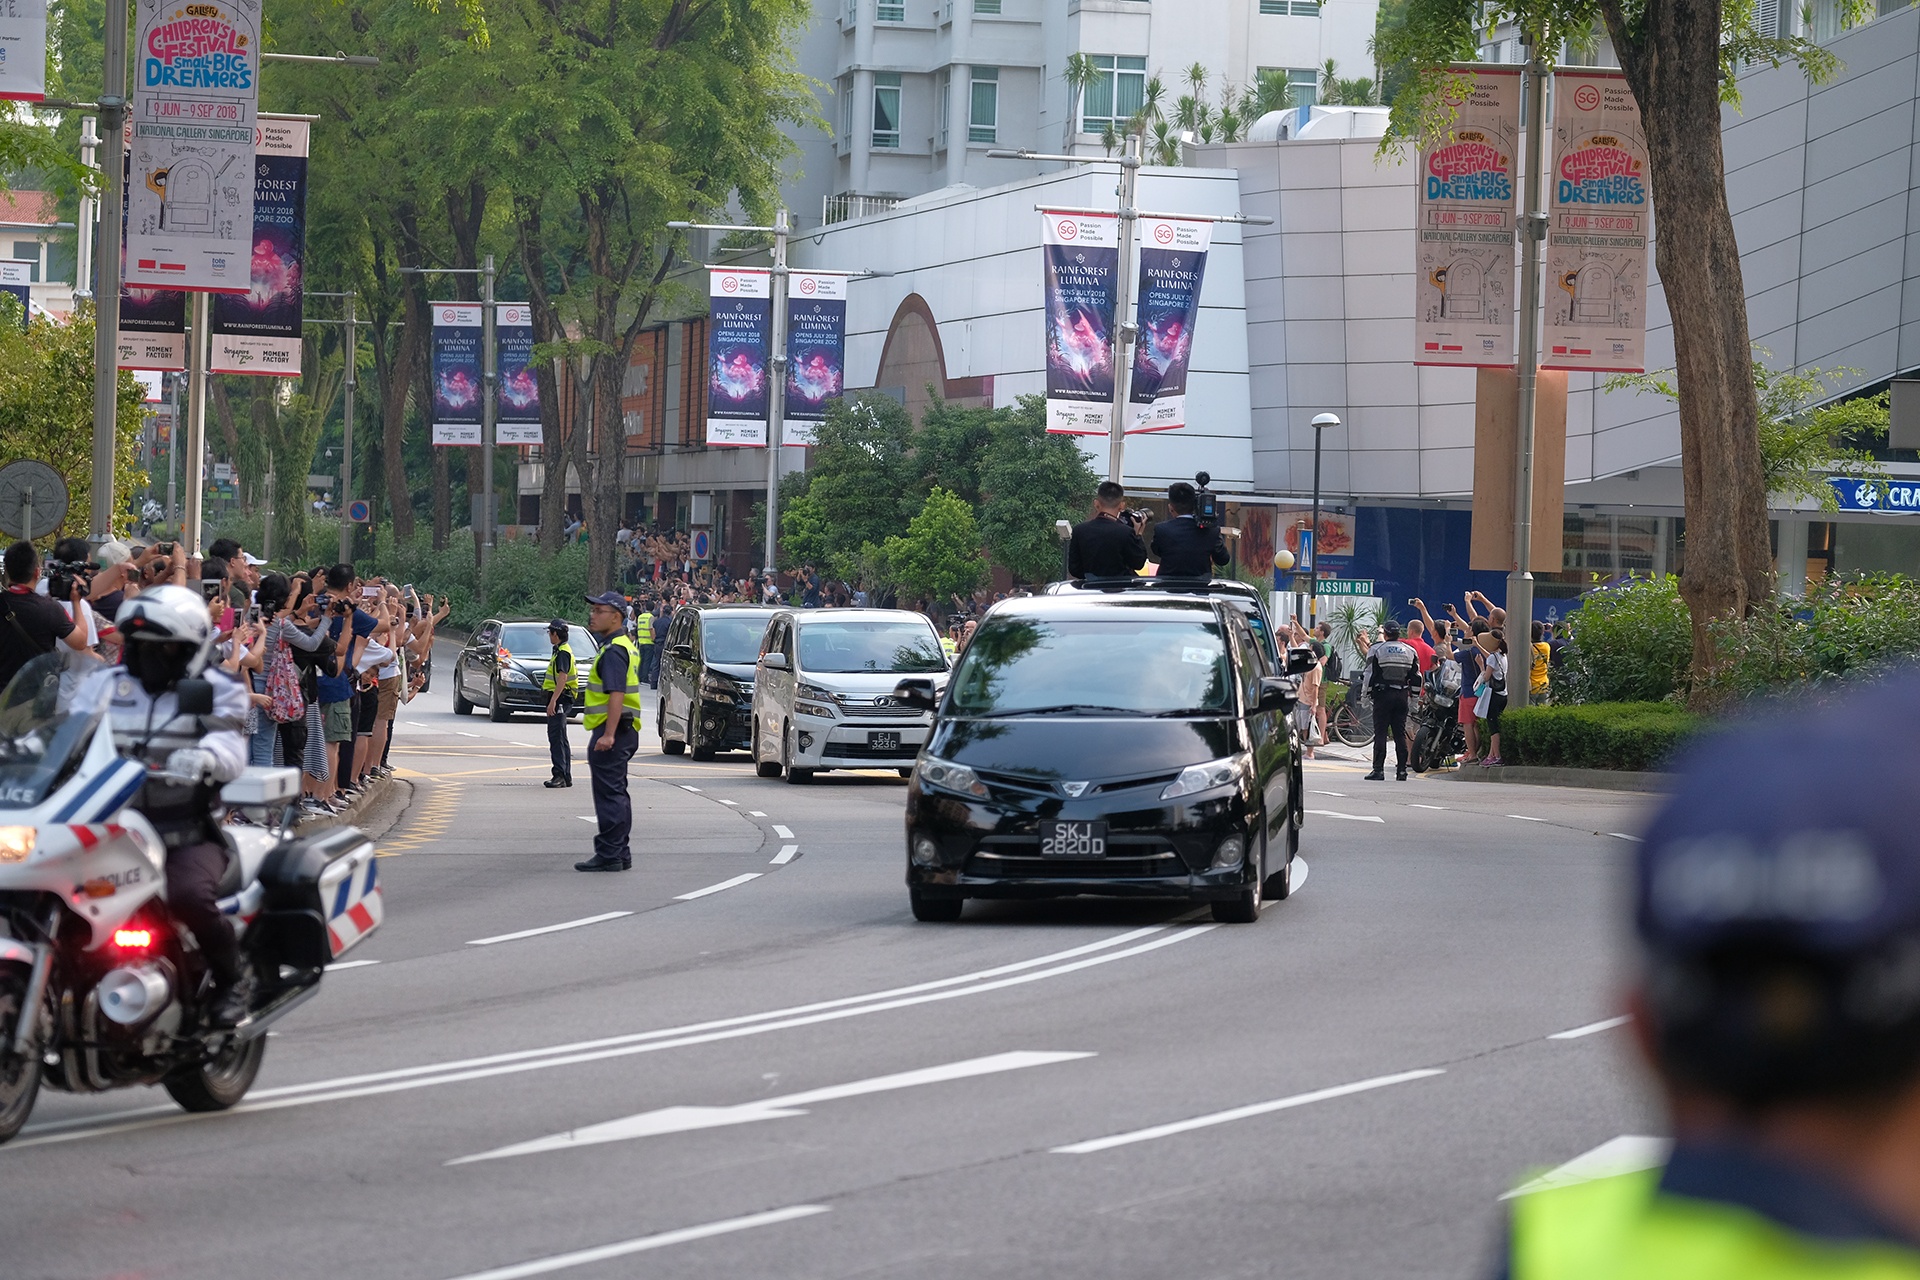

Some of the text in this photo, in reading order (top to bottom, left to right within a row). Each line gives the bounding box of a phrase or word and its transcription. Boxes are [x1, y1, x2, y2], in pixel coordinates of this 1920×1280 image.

[213, 53, 248, 71] BIG
[1578, 92, 1597, 104] SG
[154, 102, 237, 119] 9 JUN 9 SEP 2018
[1603, 104, 1634, 112] Possible
[140, 125, 175, 137] NATIONAL
[176, 126, 207, 139] GALLERY
[208, 127, 250, 141] SINGAPORE
[265, 127, 291, 135] Passion
[265, 134, 284, 142] Made
[265, 142, 293, 150] Possible
[1480, 171, 1508, 186] BIG
[1613, 175, 1641, 190] BIG
[256, 179, 298, 191] FOREST
[254, 191, 287, 202] MINA
[257, 206, 276, 214] JULY
[276, 206, 294, 215] 2018
[276, 215, 294, 224] ZOO
[1435, 212, 1501, 225] 9 JUN 9 SEP 2018
[1565, 217, 1633, 230] 9 JUN 9 SEP 2018
[1060, 225, 1075, 235] SG
[1157, 229, 1171, 239] SG
[1423, 231, 1510, 243] NATIONAL GALLERY SINGAPORE
[1553, 235, 1643, 248] NATIONAL GALLERY SINGAPORE
[1051, 265, 1109, 276] RAINFOREST
[802, 282, 814, 290] SG
[1060, 276, 1099, 286] LUMINA
[1156, 279, 1194, 291] LUMINA
[1054, 296, 1090, 304] SINGAPORE
[1149, 291, 1185, 301] OPENS JULY
[1148, 299, 1184, 308] SINGAPORE
[716, 312, 762, 321] RAINFOREST
[794, 314, 839, 323] RAINFOREST
[723, 321, 755, 329] LUMINA
[801, 322, 832, 331] LUMINA
[223, 347, 250, 359] Singapore
[262, 350, 290, 358] MOMENT
[1156, 412, 1176, 420] FACTORY
[1355, 582, 1369, 593] RD
[878, 732, 890, 741] EJ
[872, 740, 896, 749] 323G
[1055, 823, 1091, 839] SKJ
[1042, 838, 1104, 854] 2820D
